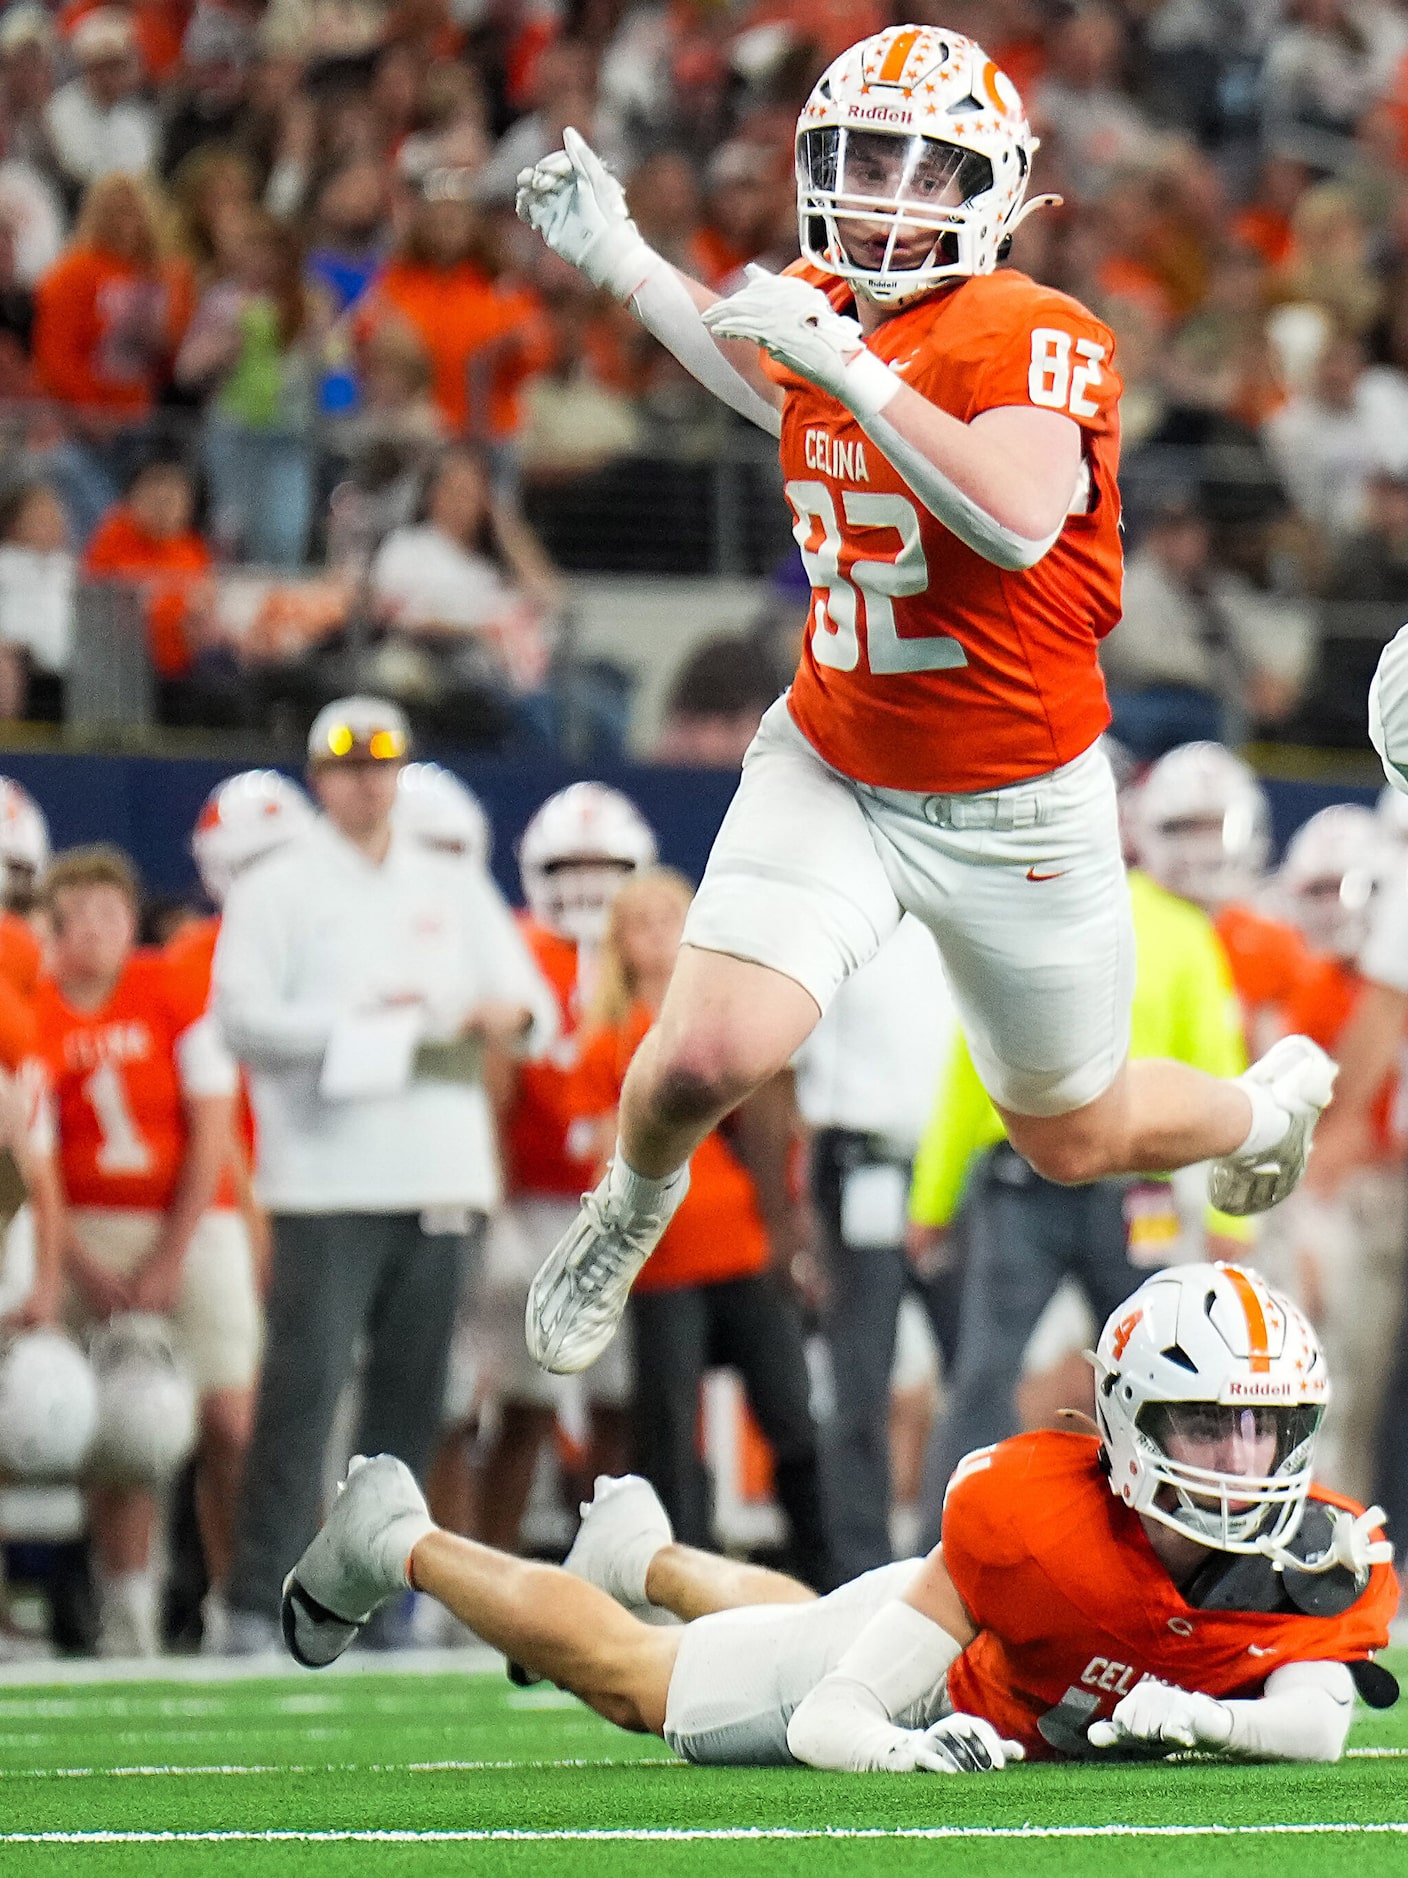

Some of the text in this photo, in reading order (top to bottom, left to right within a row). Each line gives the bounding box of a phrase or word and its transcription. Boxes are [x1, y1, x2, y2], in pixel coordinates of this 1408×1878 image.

[848, 104, 912, 124] Riddell
[1028, 327, 1105, 418] 82
[805, 429, 870, 482] CELINA
[785, 480, 969, 676] 82
[83, 1060, 158, 1178] 1
[1230, 1382, 1291, 1396] Riddell
